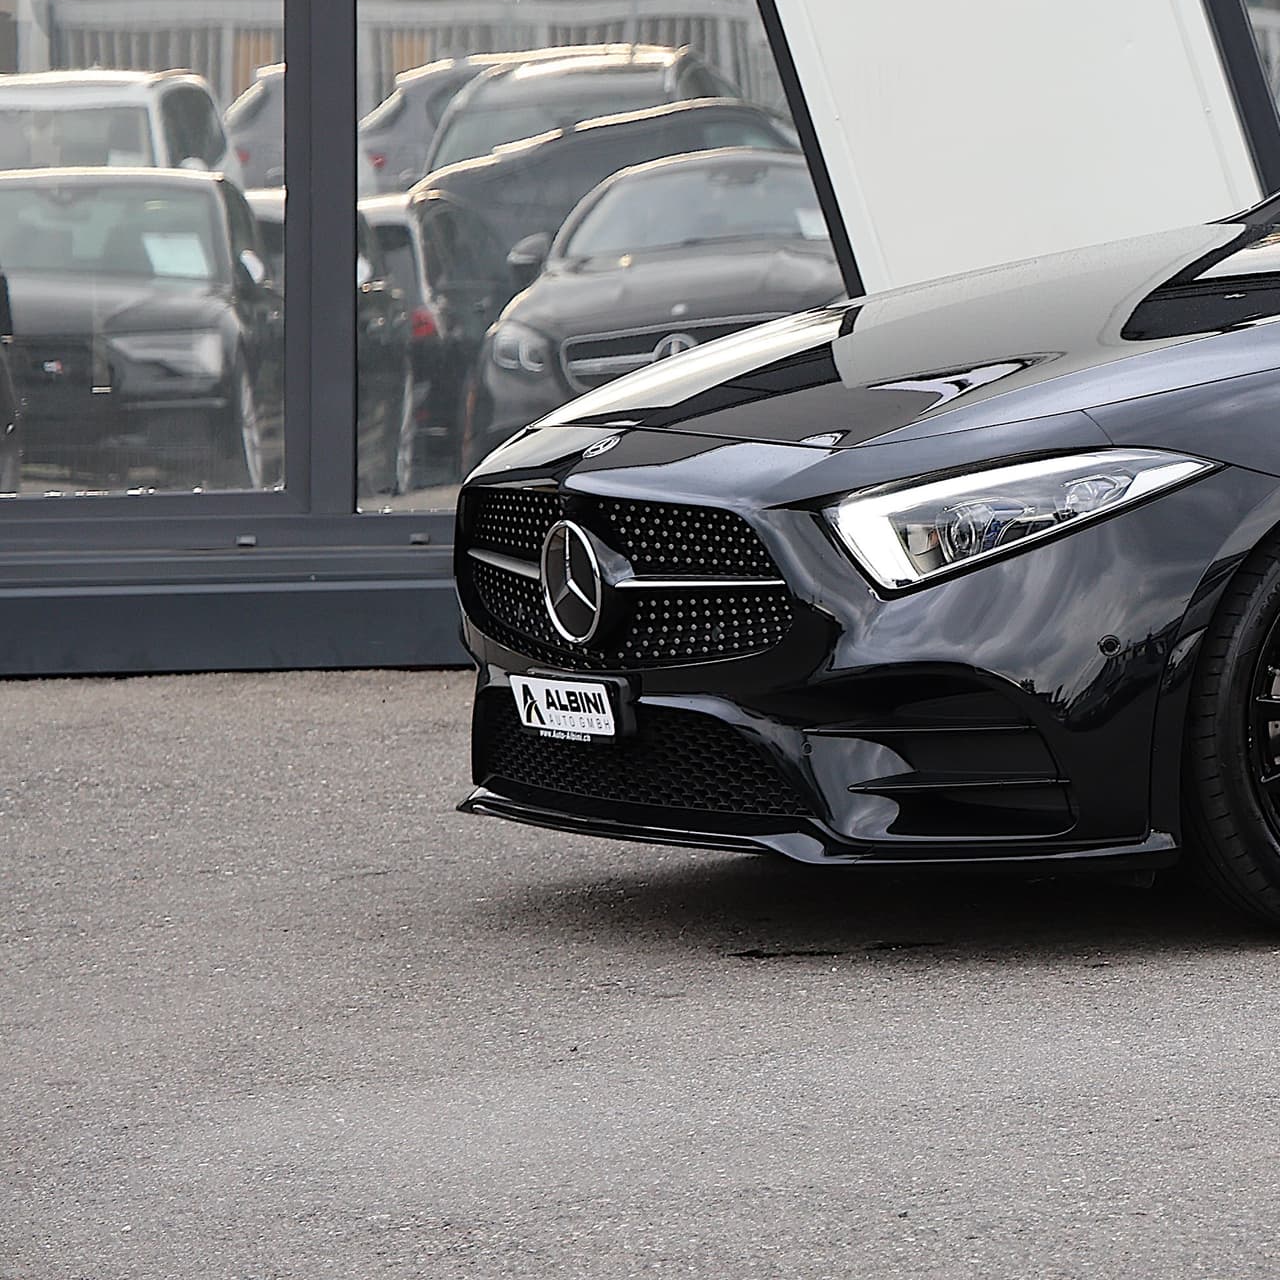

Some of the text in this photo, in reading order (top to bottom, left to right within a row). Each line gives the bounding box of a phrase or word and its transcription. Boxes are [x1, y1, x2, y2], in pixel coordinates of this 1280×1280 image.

[545, 688, 607, 715] ALBINI
[547, 713, 612, 730] AUTO GMBH
